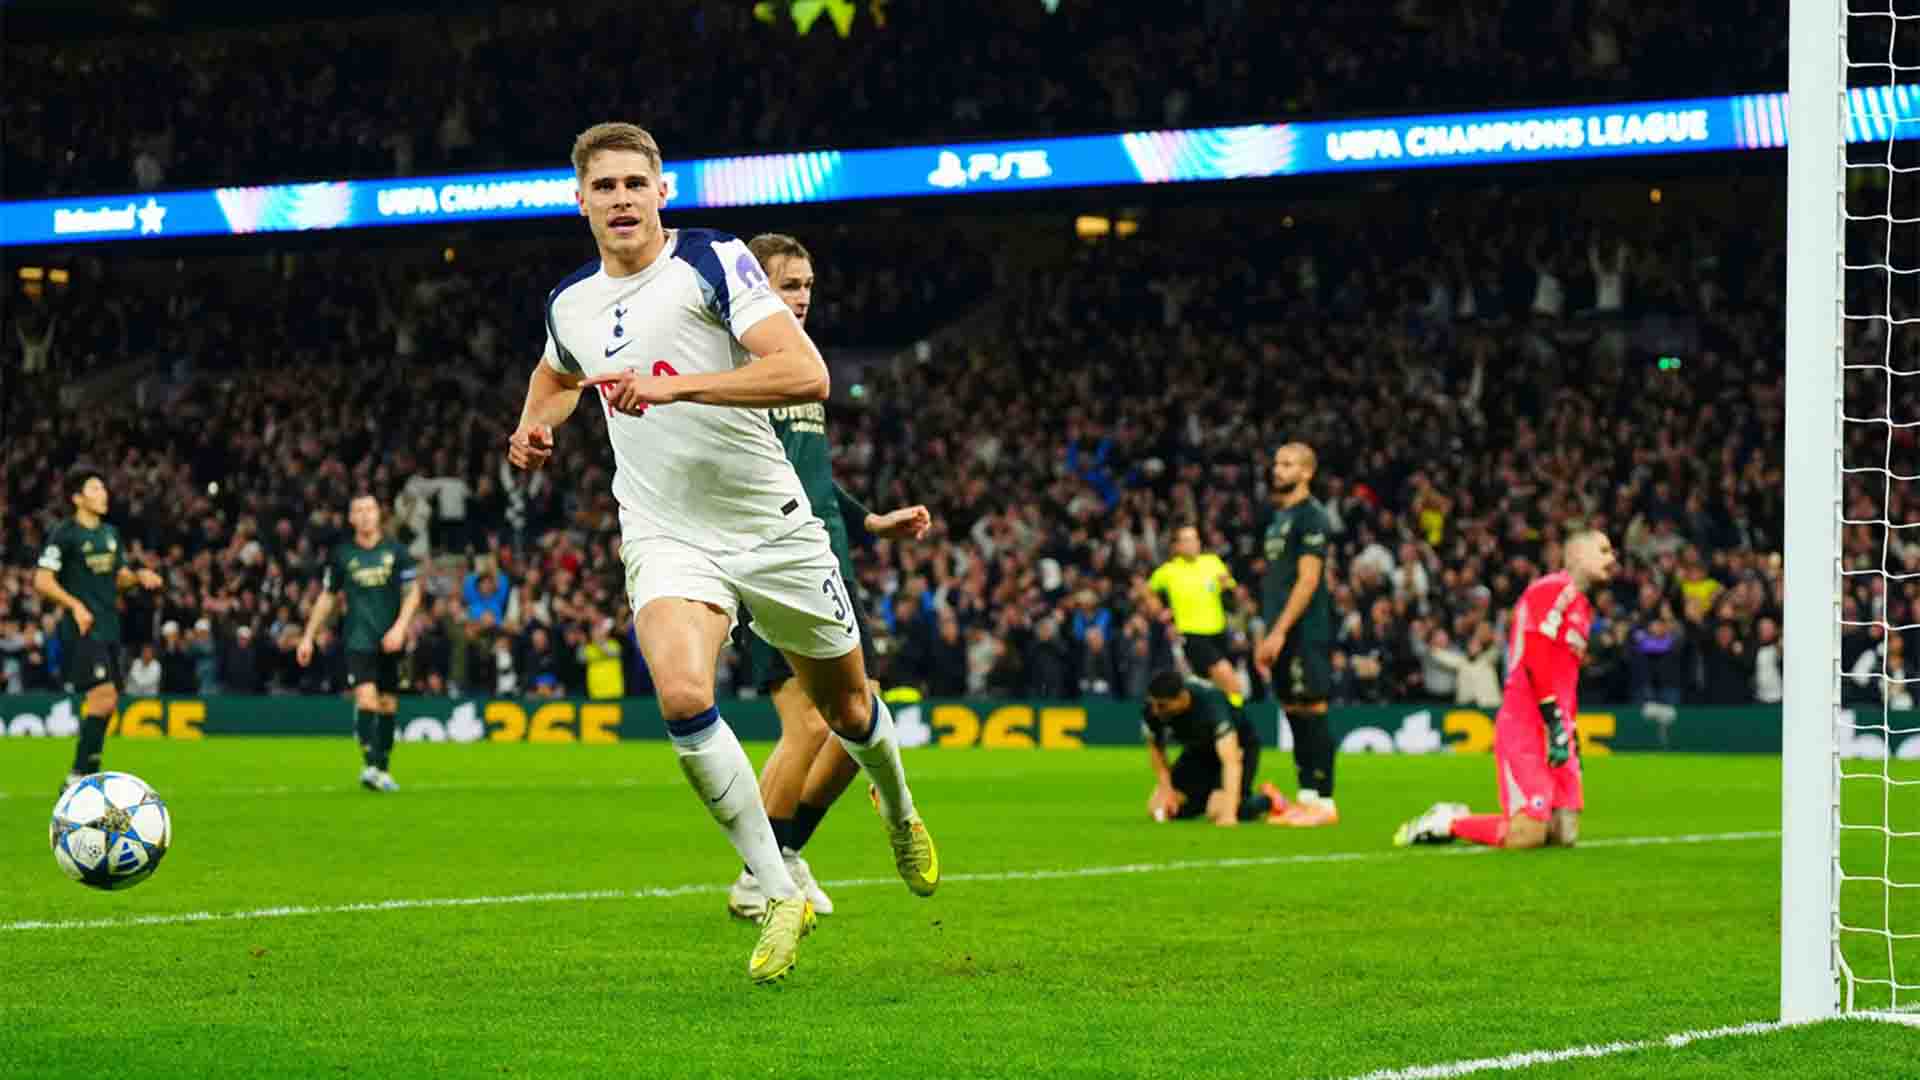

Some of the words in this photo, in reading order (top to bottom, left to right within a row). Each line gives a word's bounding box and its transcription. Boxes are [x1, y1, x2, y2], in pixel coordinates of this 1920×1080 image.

[1326, 129, 1403, 161] UEFA
[1405, 118, 1585, 157] CHAMPIONS
[1587, 109, 1709, 146] LEAGUE
[377, 186, 439, 216] UEFA
[440, 178, 578, 214] CHAMPION
[395, 701, 622, 743] et365
